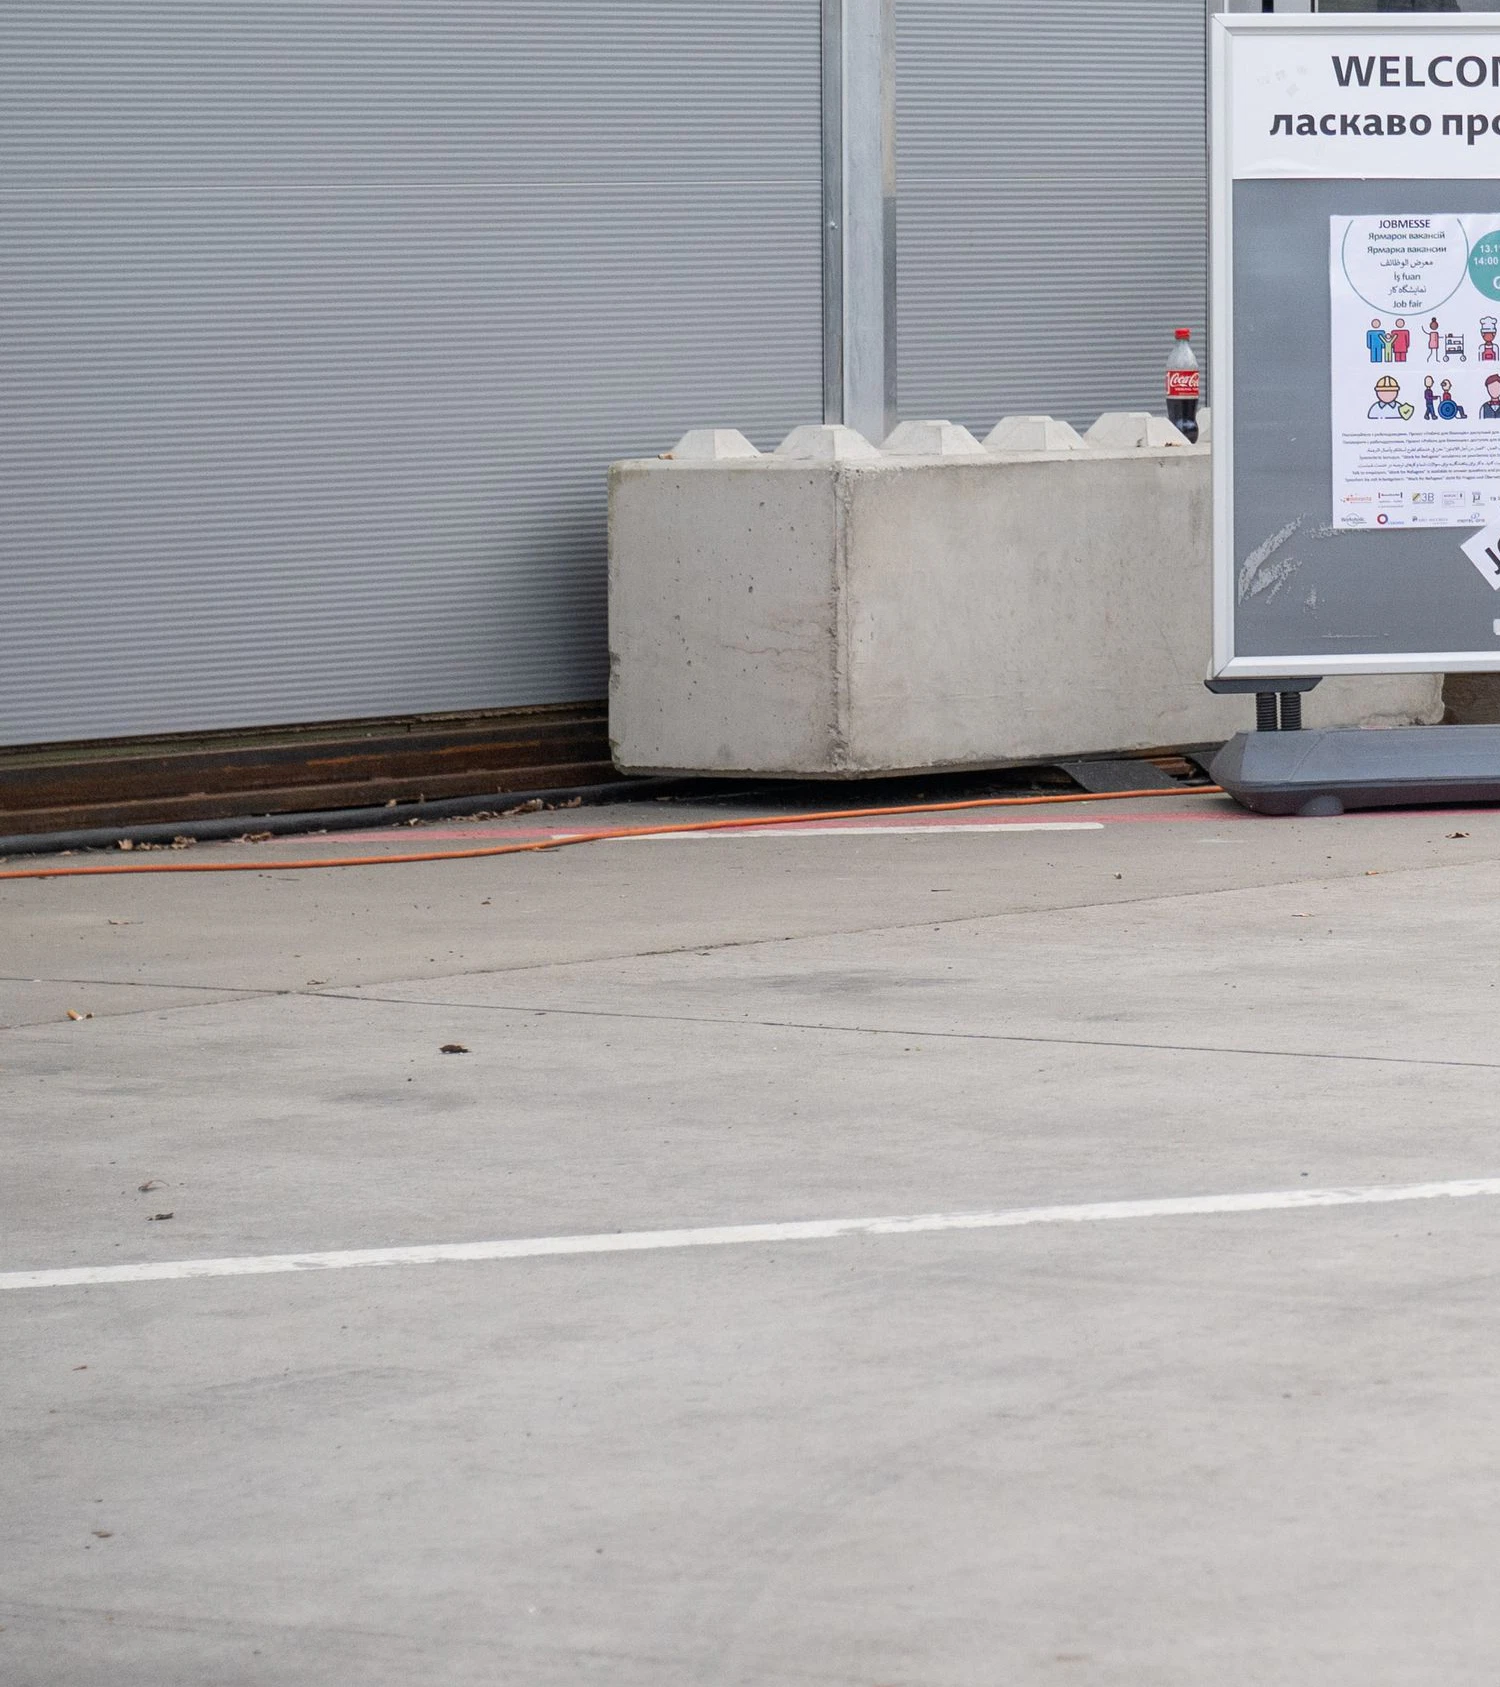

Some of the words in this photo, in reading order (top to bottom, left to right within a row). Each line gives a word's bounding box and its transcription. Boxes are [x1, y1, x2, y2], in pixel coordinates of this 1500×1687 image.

[1269, 113, 1432, 137] ласкаво
[1379, 219, 1431, 229] JOBMESSE
[1368, 233, 1407, 241] Ярмарок
[1408, 231, 1445, 239] вакансій
[1367, 246, 1406, 255] Ярмарка
[1474, 257, 1499, 265] 14:00
[1393, 300, 1407, 308] Job
[1408, 300, 1423, 308] fair
